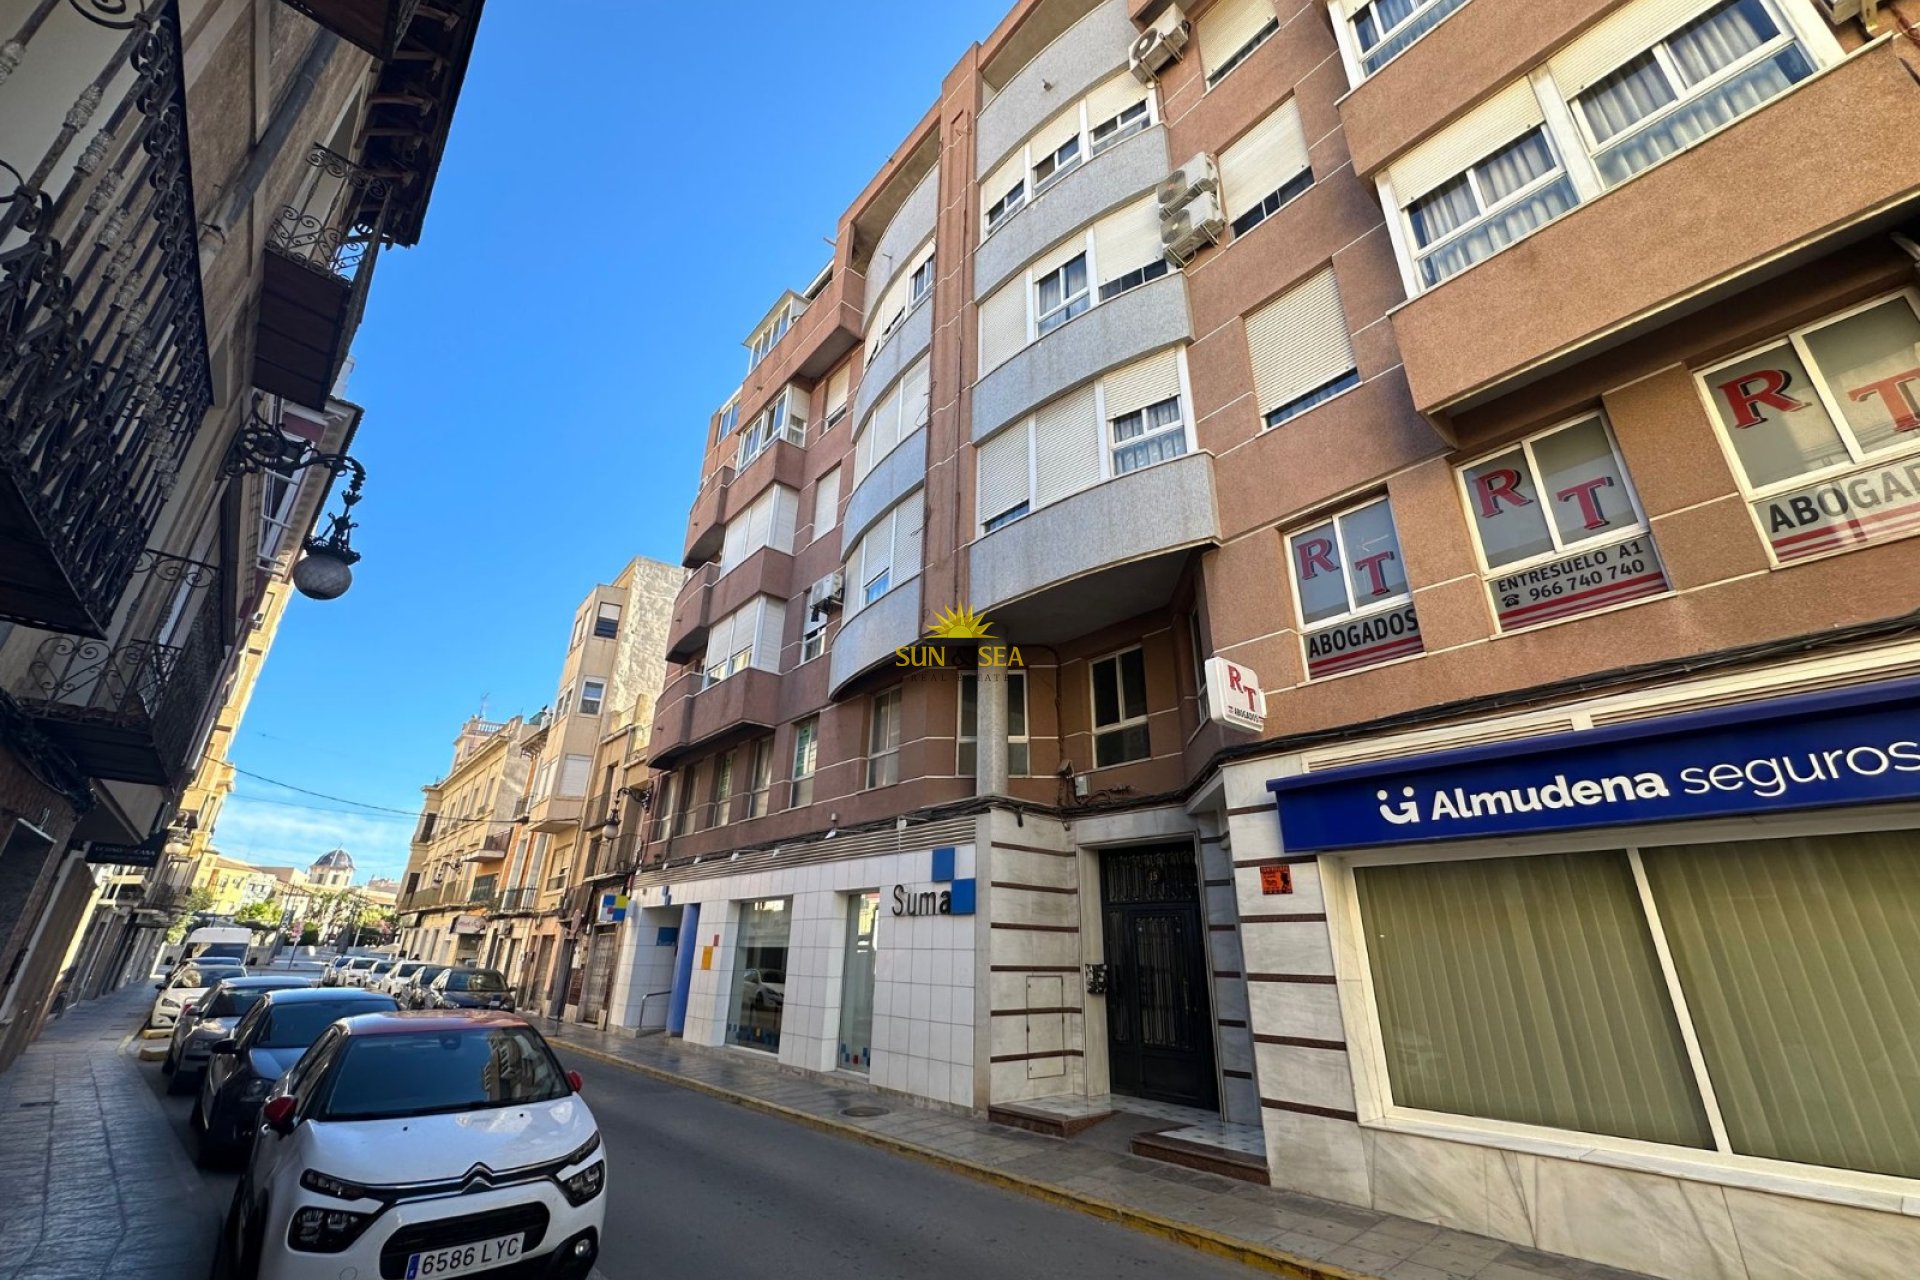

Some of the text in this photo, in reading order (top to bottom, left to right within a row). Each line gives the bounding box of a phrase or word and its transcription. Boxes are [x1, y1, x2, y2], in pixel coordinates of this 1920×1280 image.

[1718, 367, 1920, 432] R T
[1471, 468, 1614, 530] R T
[1297, 538, 1395, 596] R T
[1499, 542, 1644, 592] ENTRESUELO A1
[1529, 559, 1645, 601] 966 740 740
[1309, 608, 1419, 658] ABOGADOS
[1431, 741, 1920, 821] Almudena seguros
[892, 884, 951, 917] Suma
[422, 1238, 518, 1275] 6586 LYC
